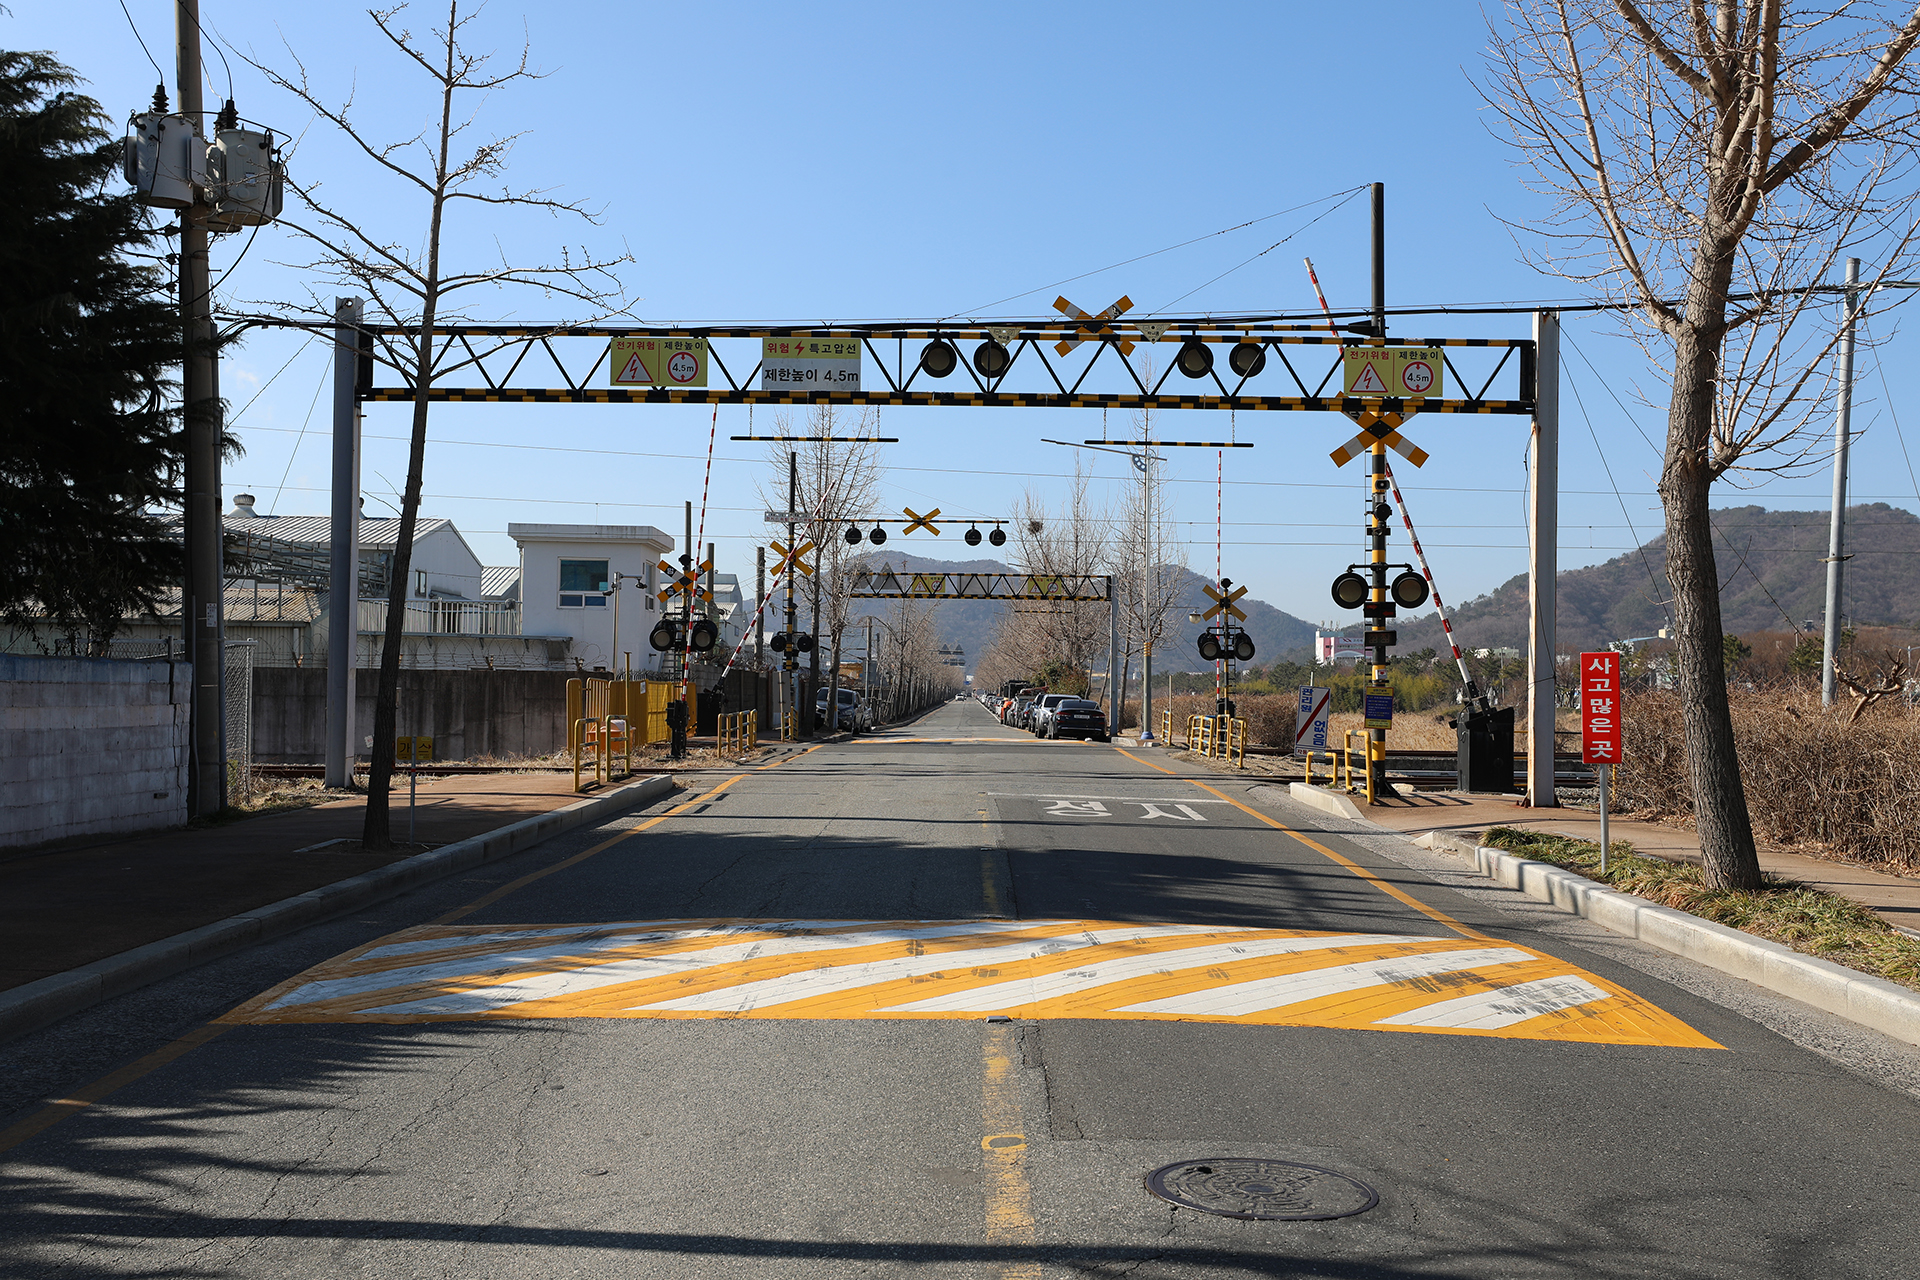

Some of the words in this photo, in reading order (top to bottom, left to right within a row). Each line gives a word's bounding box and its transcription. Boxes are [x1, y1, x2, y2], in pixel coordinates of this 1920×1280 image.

[616, 341, 655, 350] 전기위험
[664, 341, 704, 351] 제한높이
[767, 342, 790, 354] 위험
[809, 343, 857, 354] 특고압선
[1349, 351, 1390, 360] 전기위험
[1398, 350, 1439, 360] 제한높이
[672, 363, 695, 372] 4.5m
[764, 368, 818, 382] 제한높이
[823, 369, 859, 383] 4.5m
[1406, 372, 1430, 382] 4.5m
[1588, 658, 1613, 692] 사고
[1589, 698, 1614, 733] 많은
[1589, 741, 1614, 758] 곳
[1036, 799, 1209, 821] 정지
